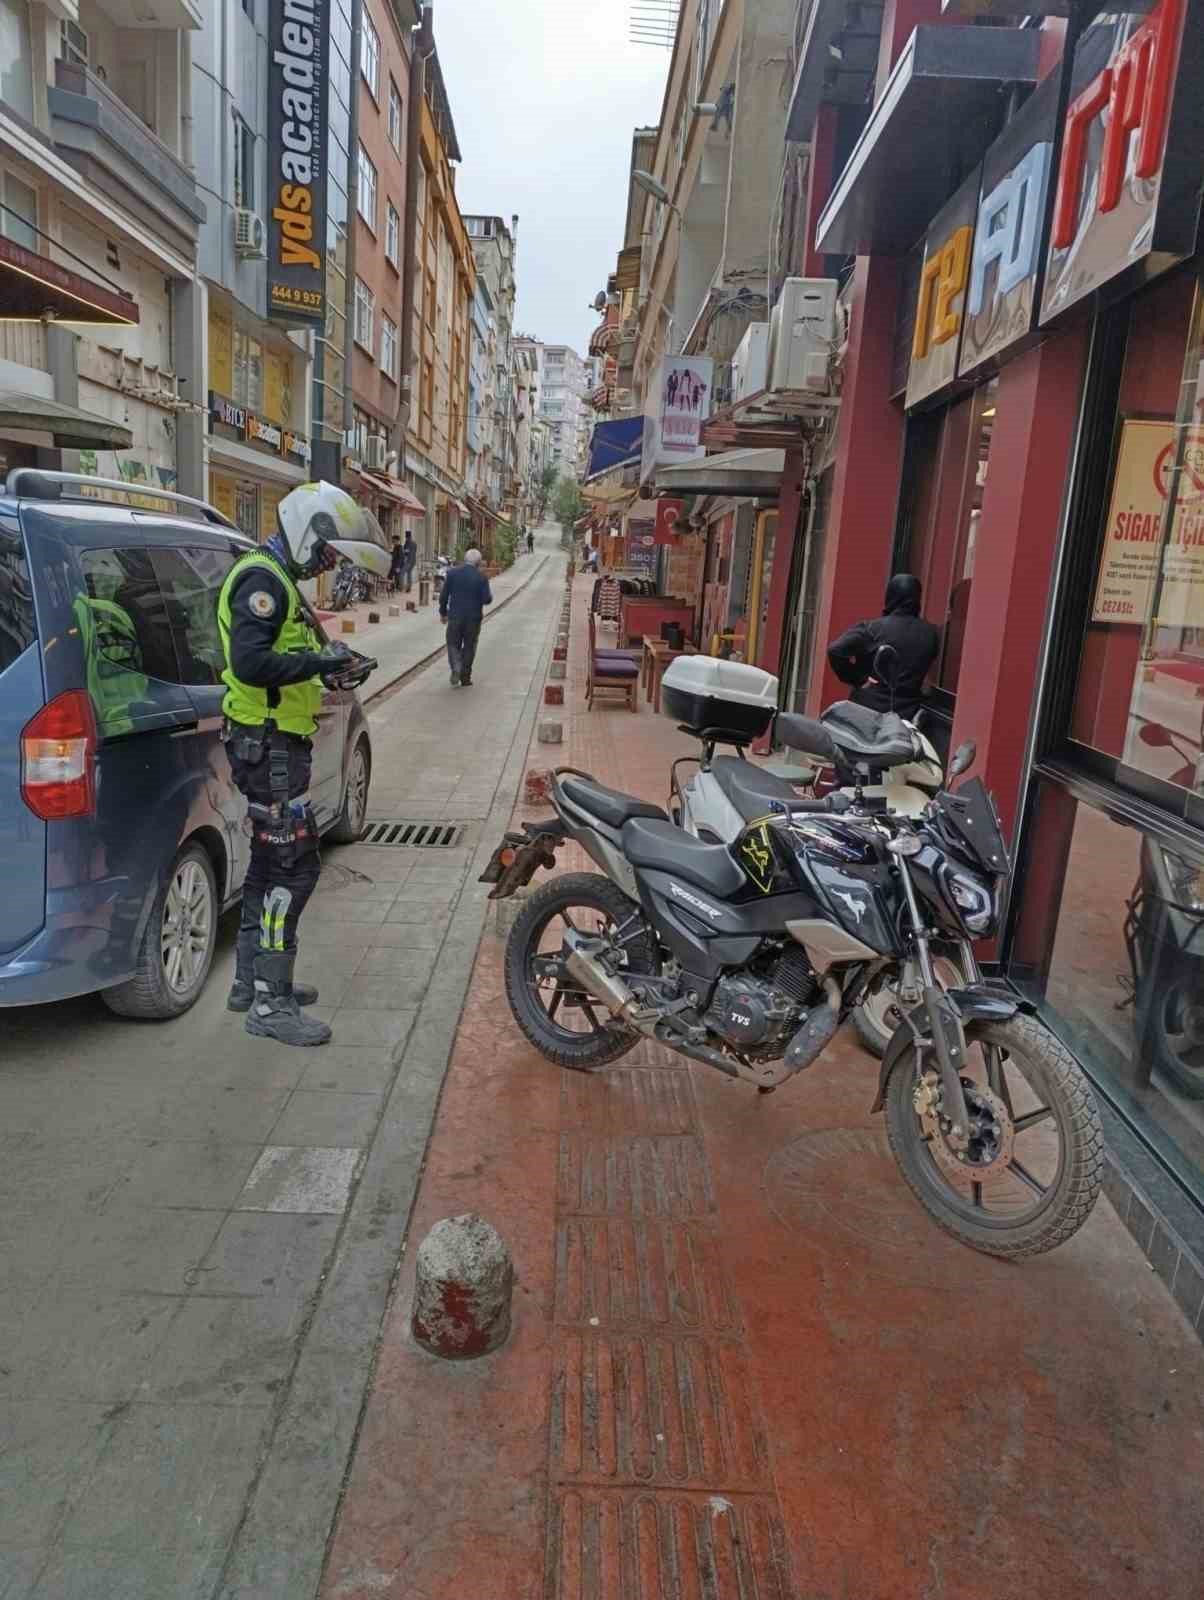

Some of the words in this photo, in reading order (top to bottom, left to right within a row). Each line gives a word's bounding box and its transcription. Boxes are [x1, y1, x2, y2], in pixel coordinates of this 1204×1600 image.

[272, 286, 291, 299] 444
[294, 289, 300, 301] 9
[303, 291, 321, 305] 937
[731, 1012, 751, 1027] TVS
